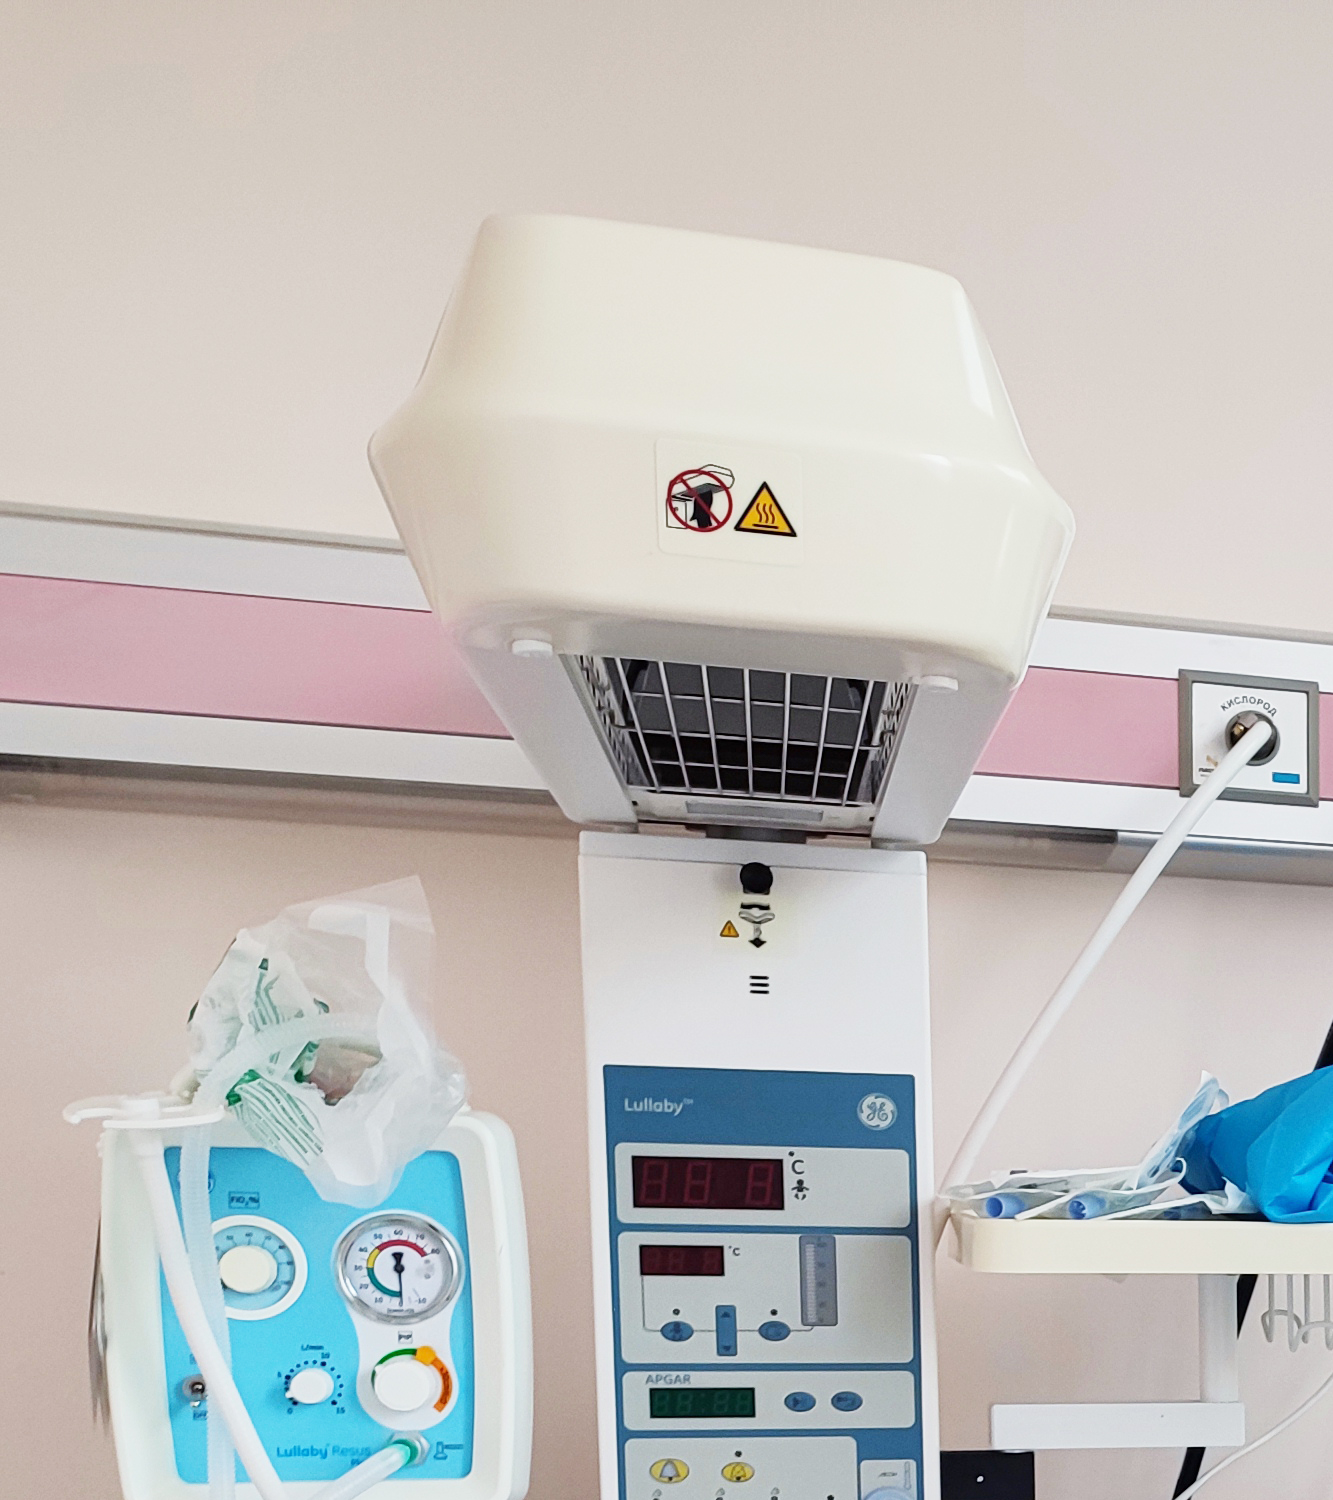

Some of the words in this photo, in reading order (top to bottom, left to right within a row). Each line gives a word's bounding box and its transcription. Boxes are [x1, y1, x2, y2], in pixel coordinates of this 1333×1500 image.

[1220, 695, 1278, 717] КИСЛОРОД
[624, 1097, 684, 1117] Lullaby
[645, 1373, 692, 1386] APGAR
[276, 1445, 329, 1460] Lullaby
